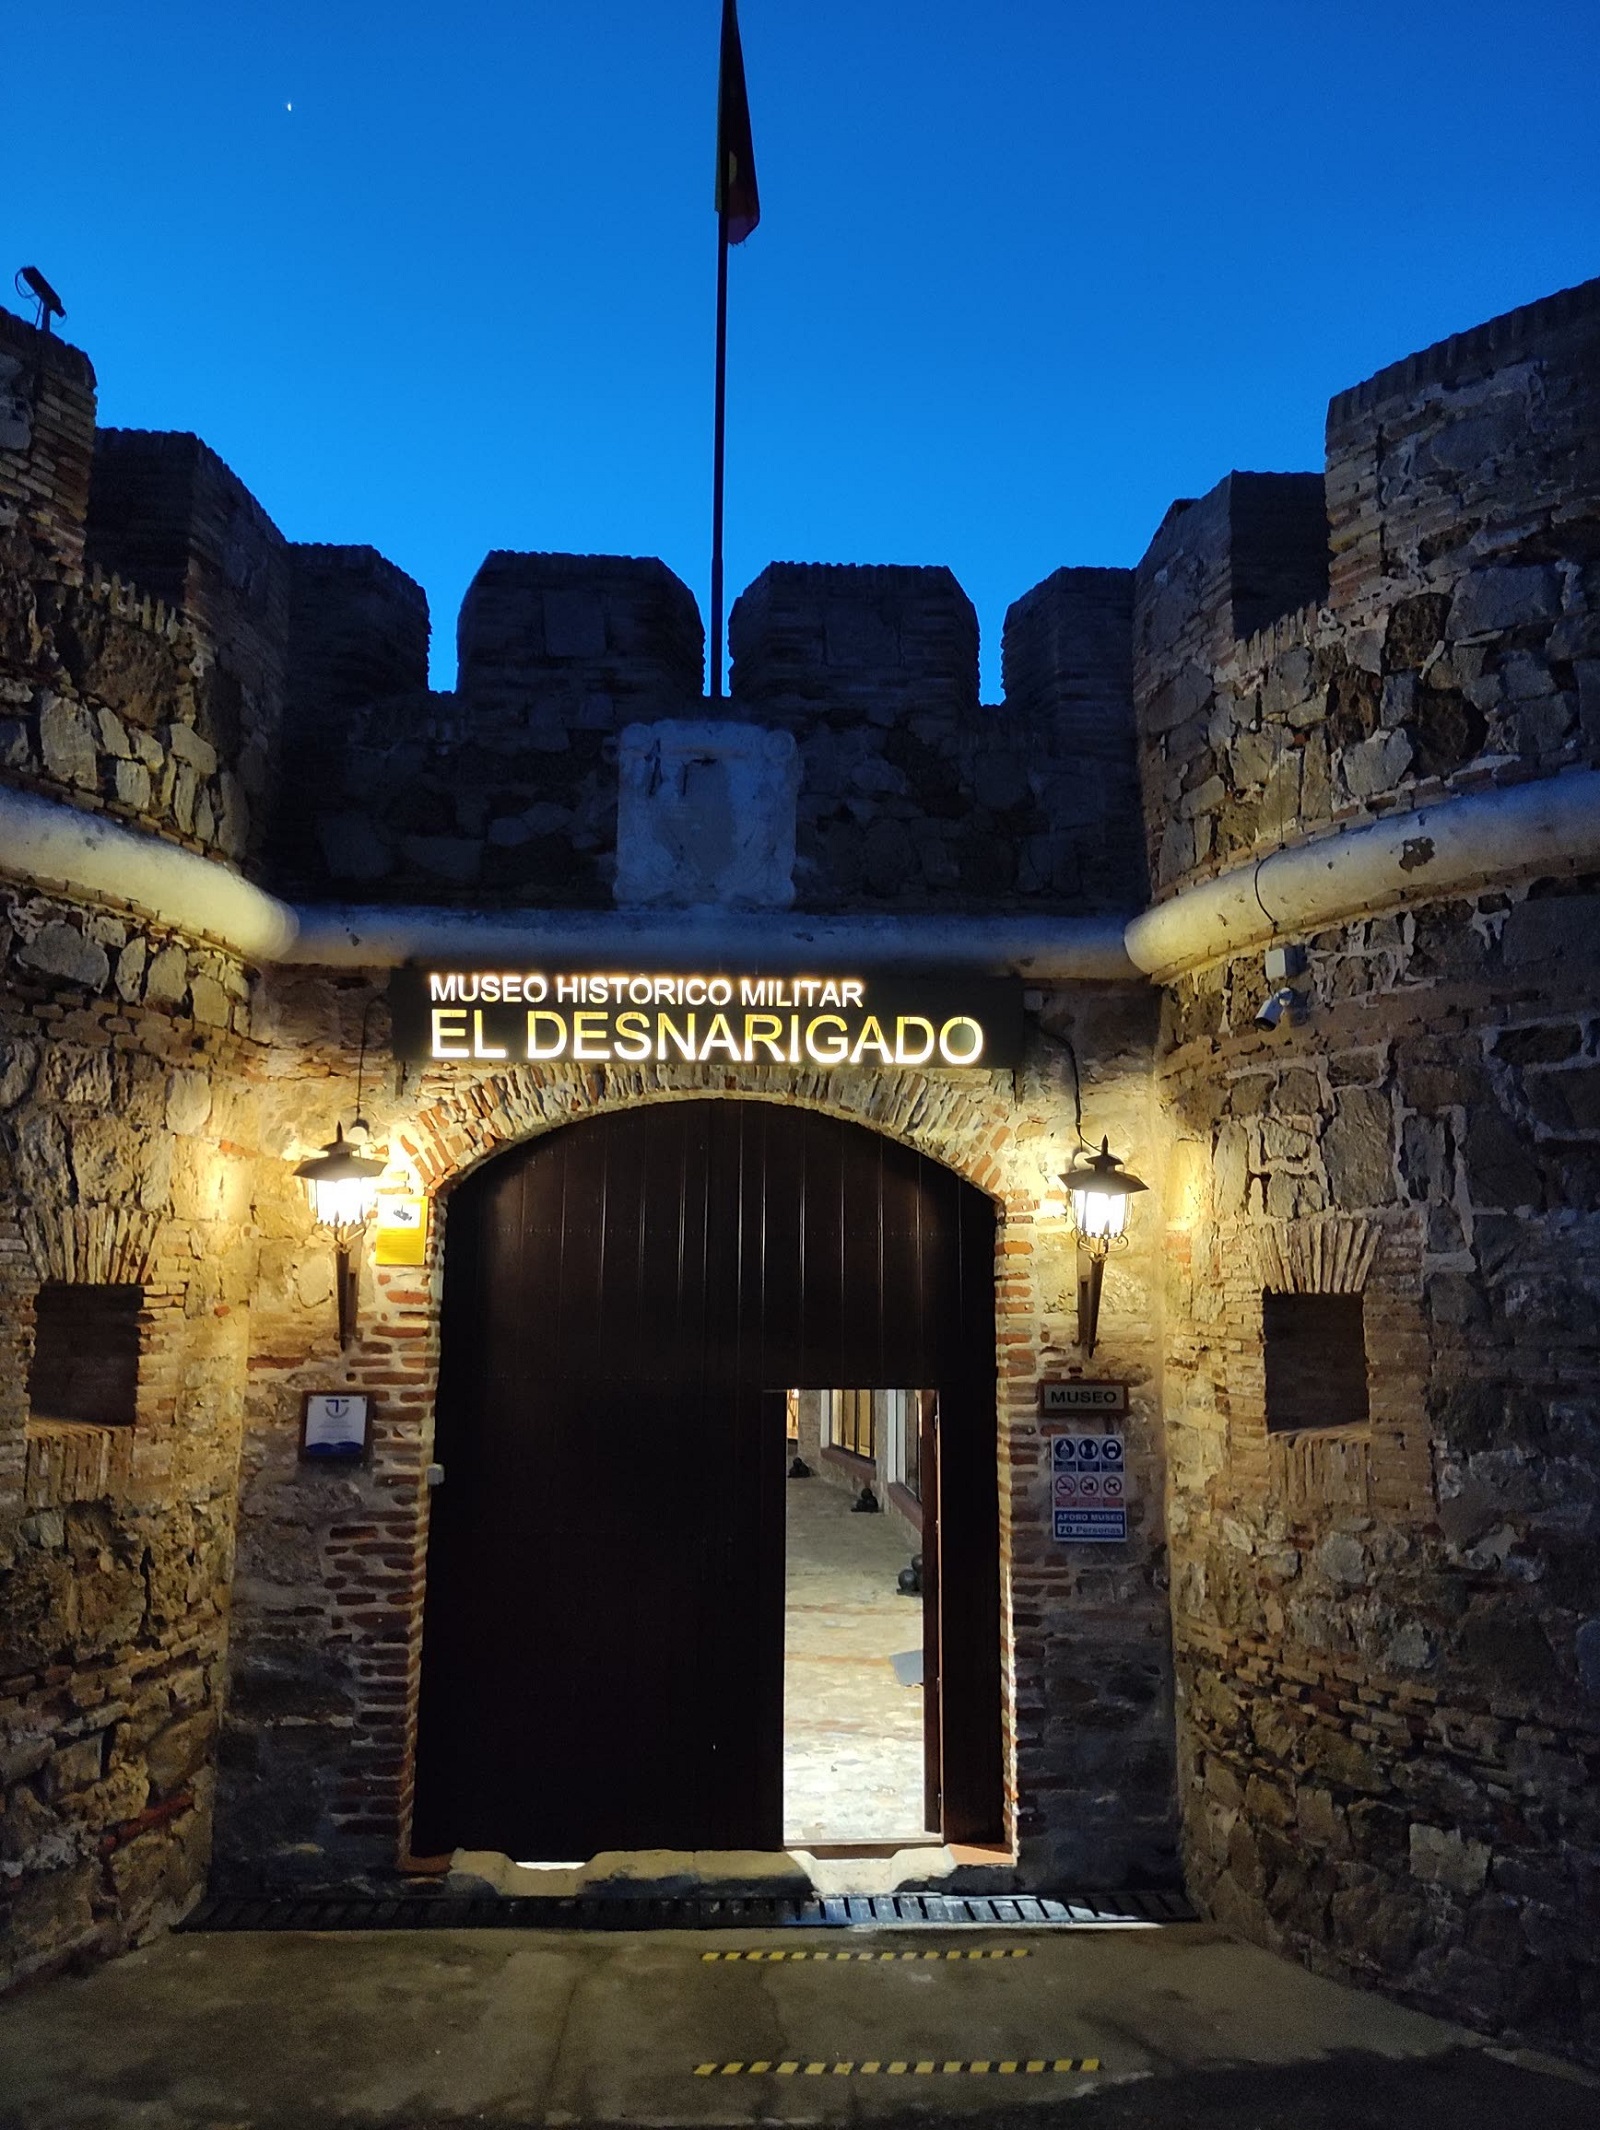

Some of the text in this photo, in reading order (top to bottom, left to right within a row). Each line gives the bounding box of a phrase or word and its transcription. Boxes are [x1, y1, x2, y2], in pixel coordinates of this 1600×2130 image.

[430, 975, 548, 1003] MUSEO
[740, 979, 864, 1008] MILITAR
[431, 1008, 983, 1064] EL DESNARIGADO
[1051, 1391, 1117, 1403] MUSEO
[1091, 1513, 1123, 1521] MUSEO
[1059, 1525, 1121, 1534] 70 Personas
